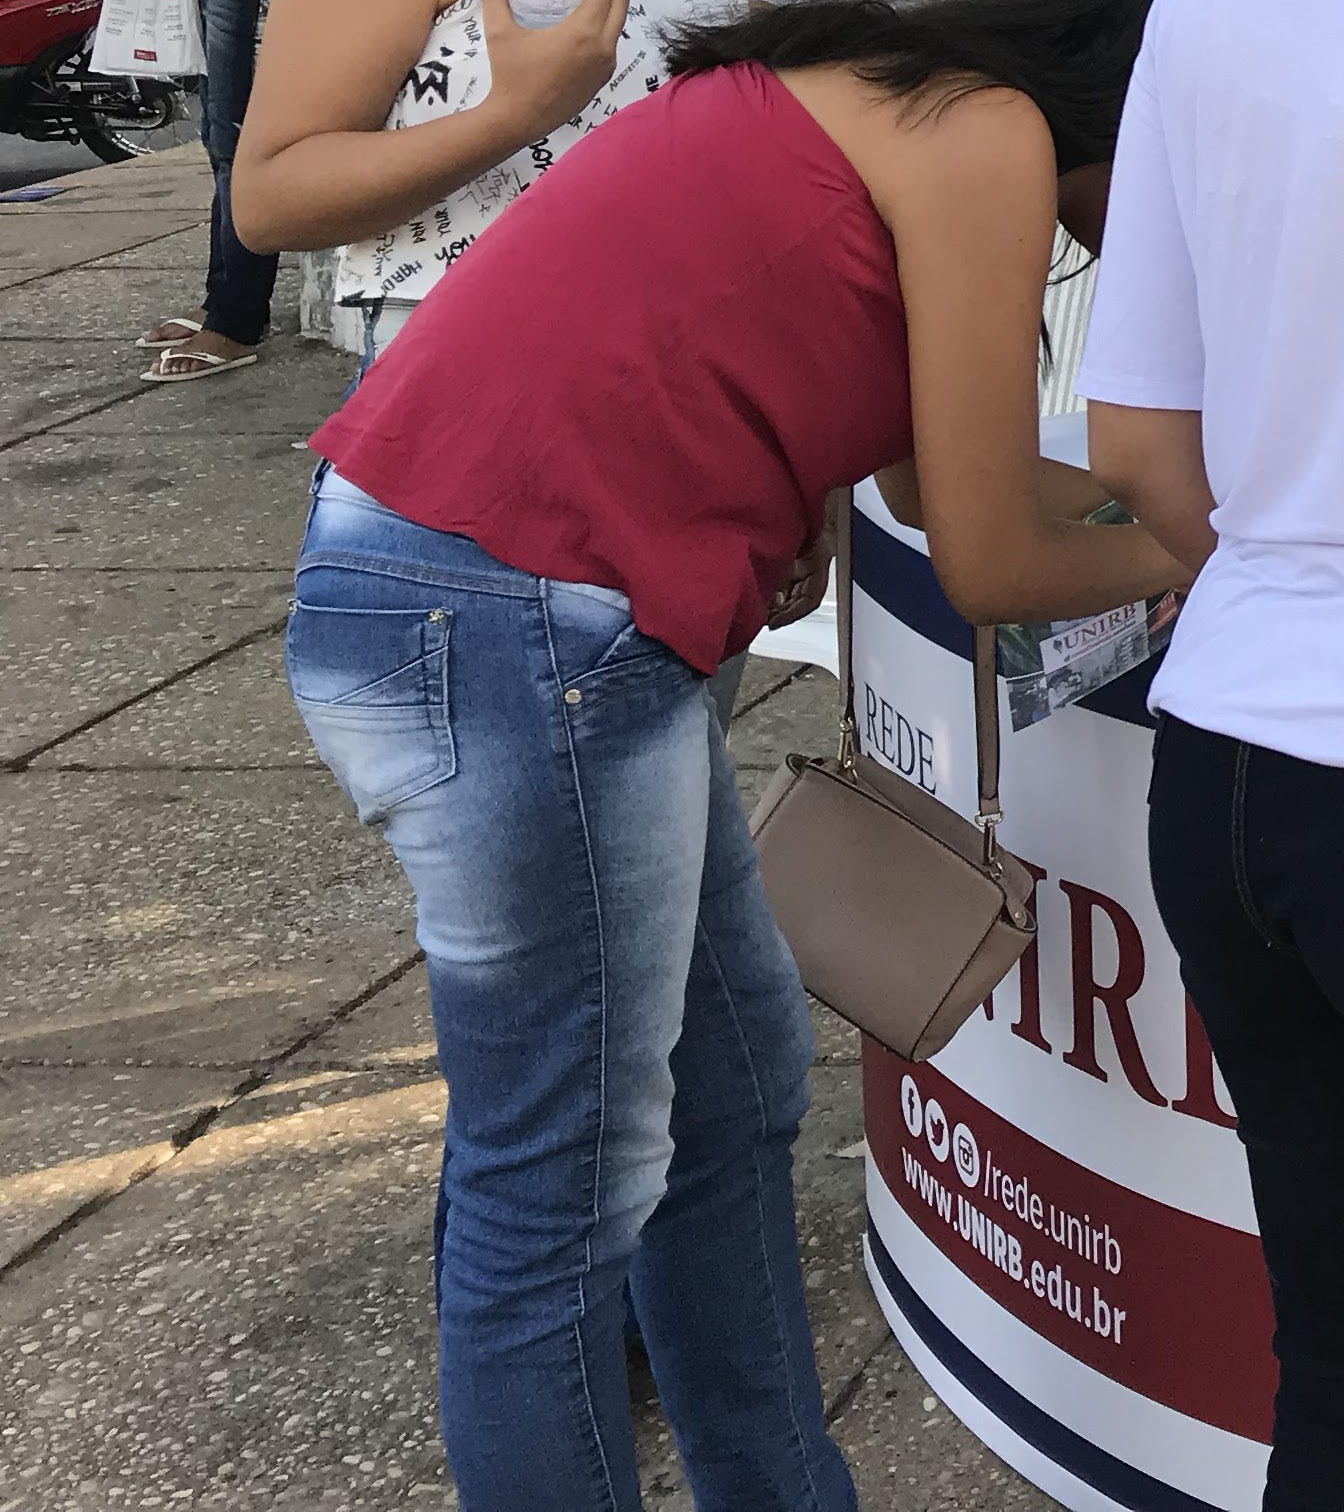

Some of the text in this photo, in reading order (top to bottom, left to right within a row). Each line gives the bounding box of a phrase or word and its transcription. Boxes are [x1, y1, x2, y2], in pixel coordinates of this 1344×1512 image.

[1063, 603, 1138, 649] UNIRB
[864, 681, 938, 796] REDE
[901, 1145, 1127, 1345] www.UNIRB.edu.br
[984, 1163, 1123, 1277] /rede.unirb
